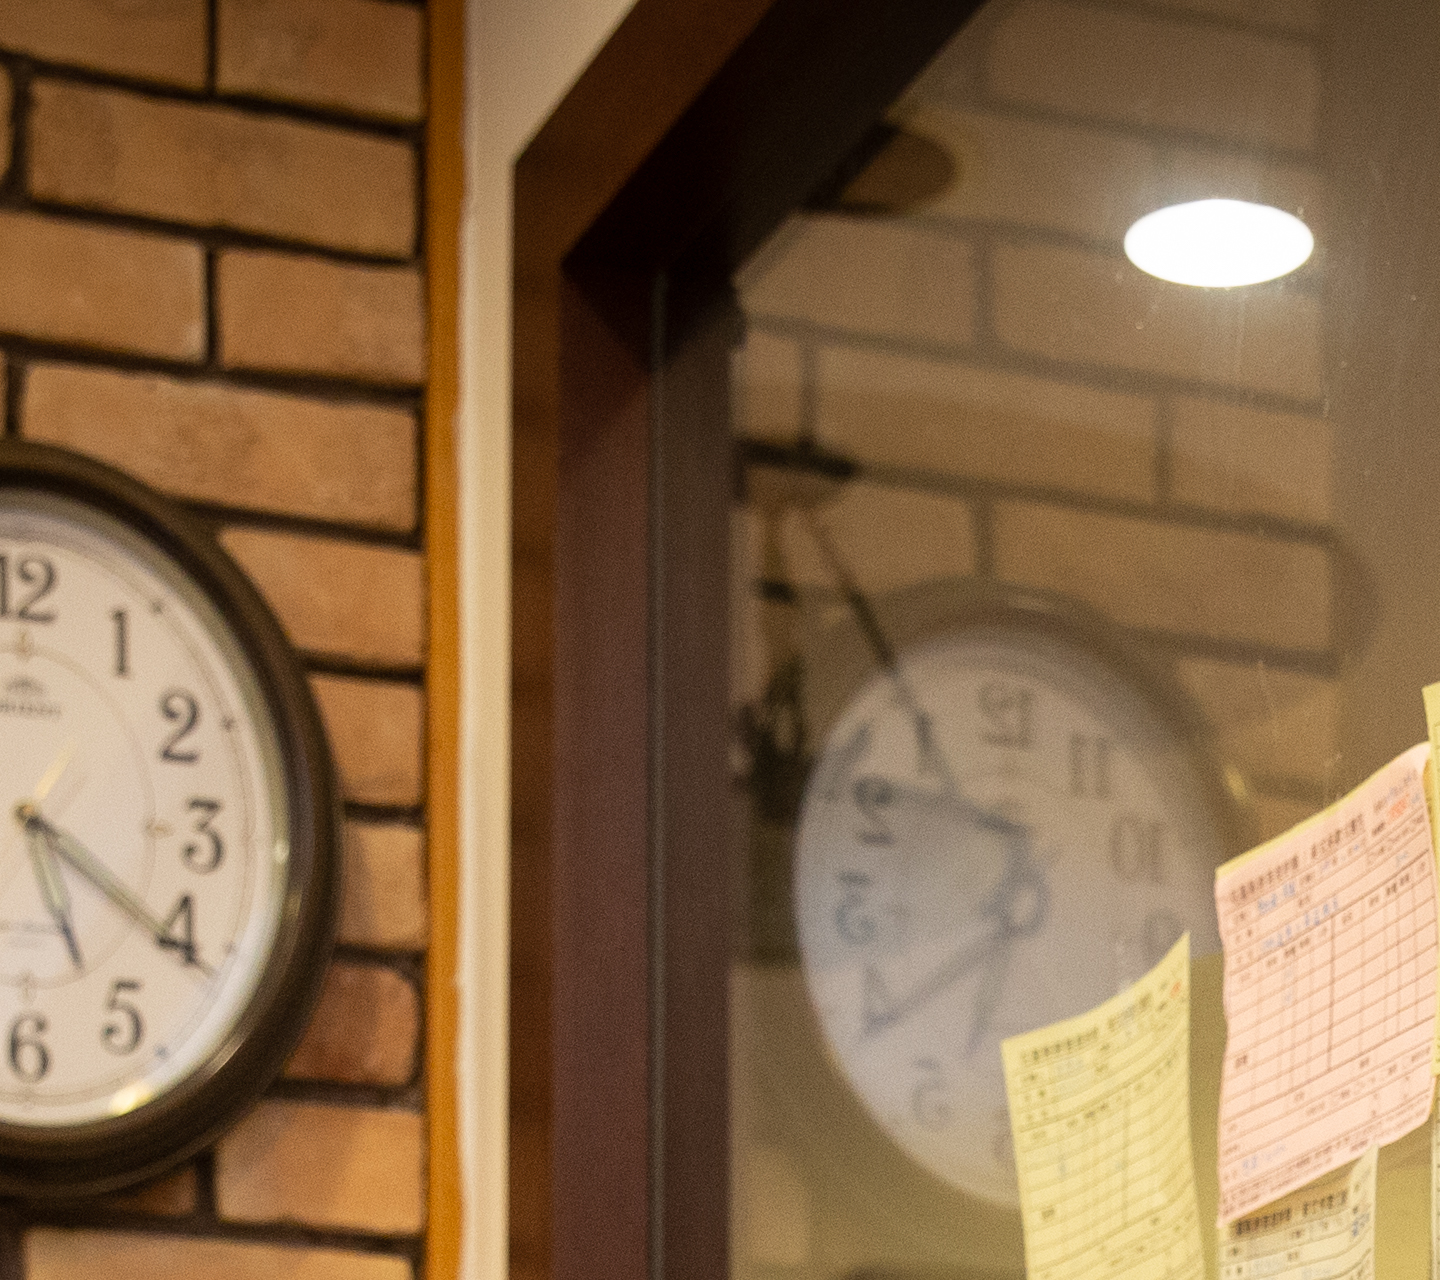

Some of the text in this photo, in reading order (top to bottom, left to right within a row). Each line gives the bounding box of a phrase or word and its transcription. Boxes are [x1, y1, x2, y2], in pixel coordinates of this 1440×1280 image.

[111, 610, 131, 677] 1
[160, 689, 199, 763] 2
[182, 800, 223, 873] 3
[160, 895, 199, 966] 4
[8, 1012, 50, 1083] 6
[101, 981, 145, 1055] 5
